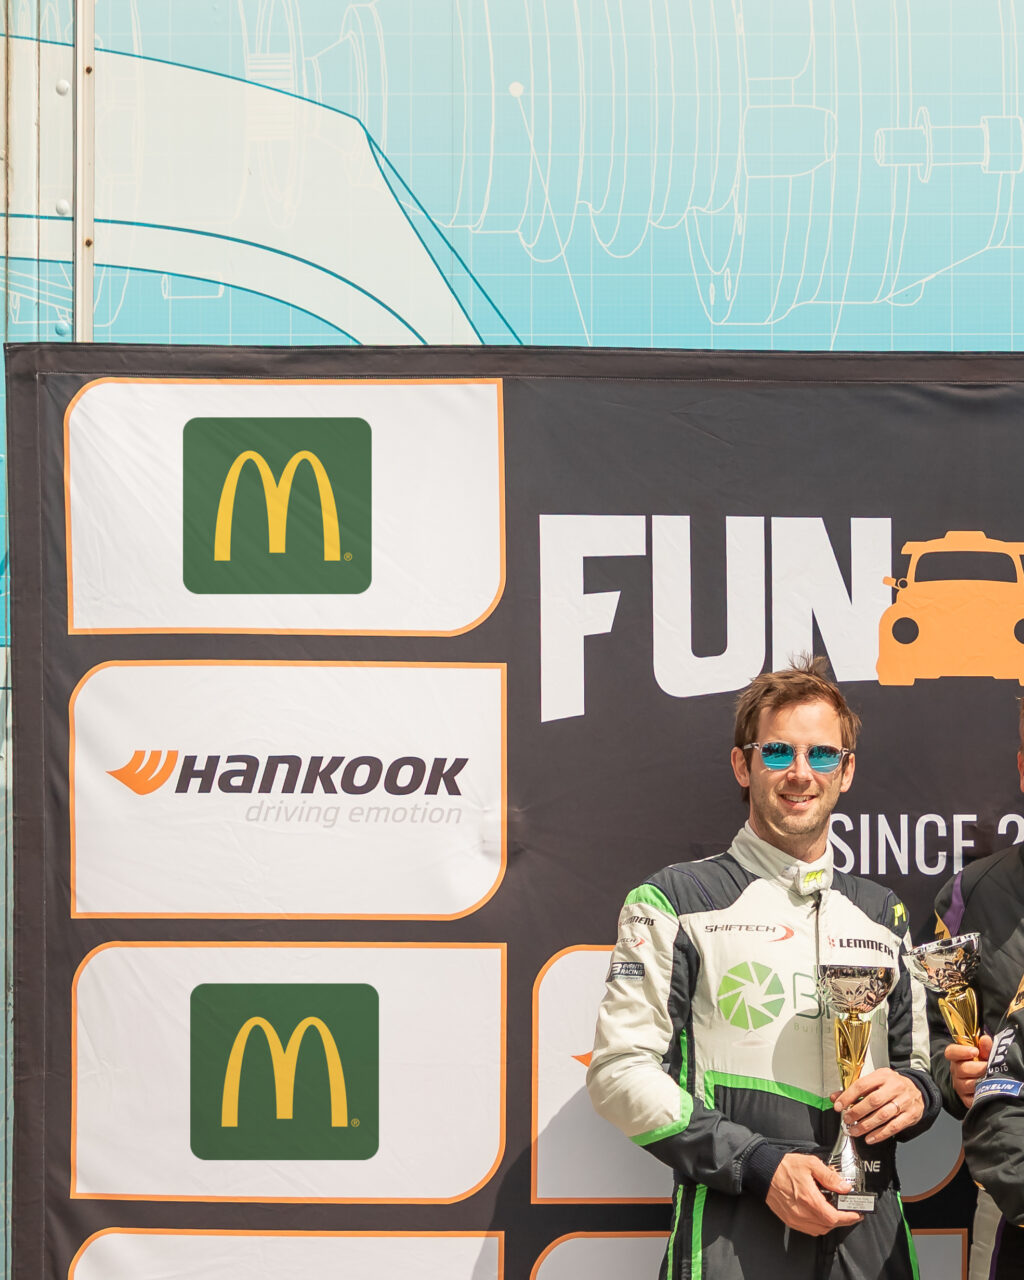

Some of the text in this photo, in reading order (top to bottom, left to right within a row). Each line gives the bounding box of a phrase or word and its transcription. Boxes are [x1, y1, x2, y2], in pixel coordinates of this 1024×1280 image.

[539, 514, 892, 723] FUN
[245, 800, 463, 828] driving emotion
[828, 813, 978, 876] SINCE
[704, 923, 777, 934] SHIFTECH
